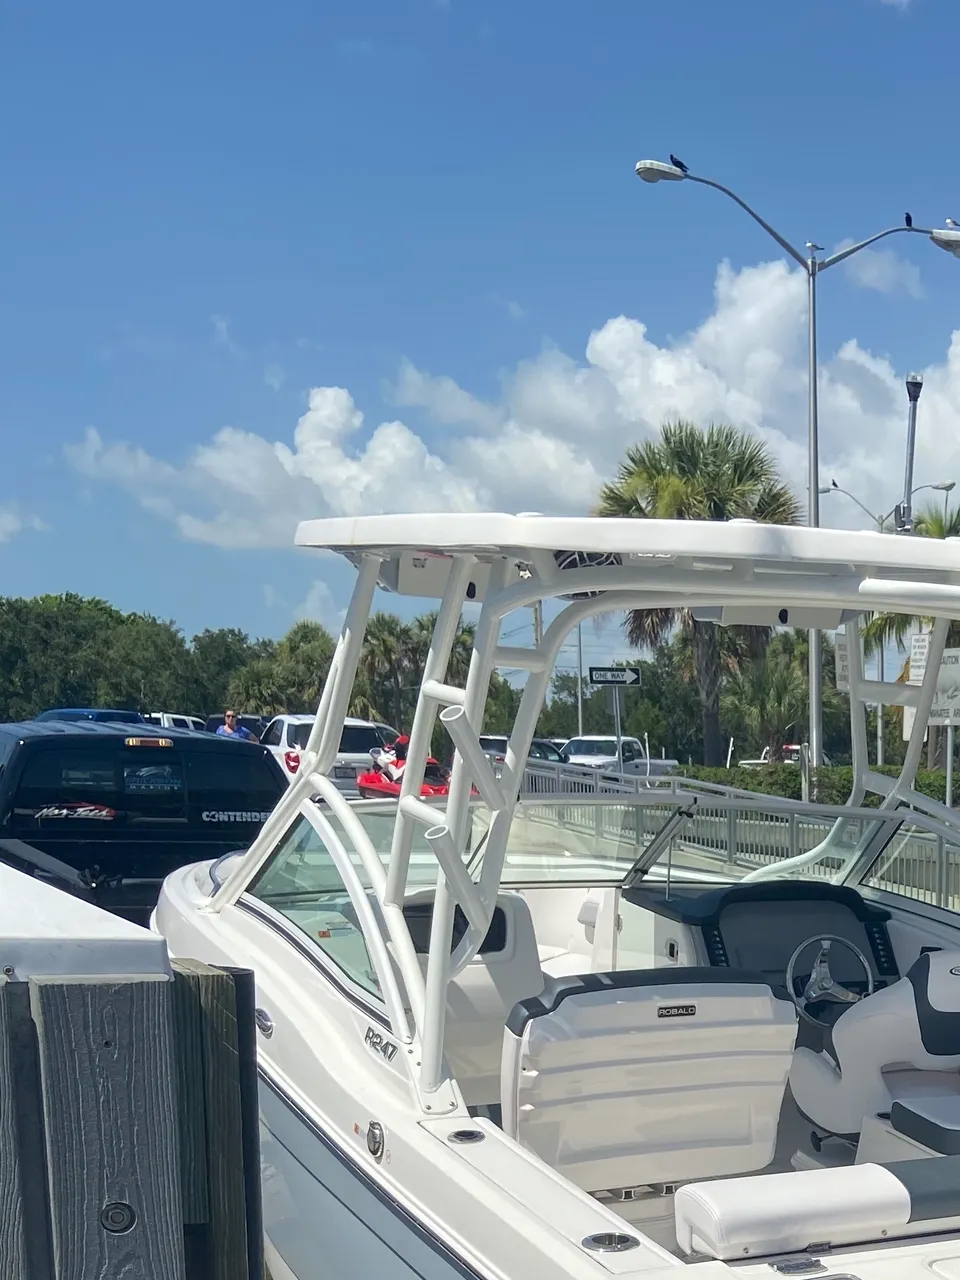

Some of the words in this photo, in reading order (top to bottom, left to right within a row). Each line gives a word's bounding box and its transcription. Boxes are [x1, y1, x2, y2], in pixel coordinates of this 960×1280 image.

[940, 655, 960, 665] AUTION
[594, 672, 608, 680] ONE
[611, 672, 626, 680] WAY
[202, 811, 272, 822] CONTENDE
[658, 1007, 696, 1016] ROBALO
[364, 1026, 399, 1062] R247
